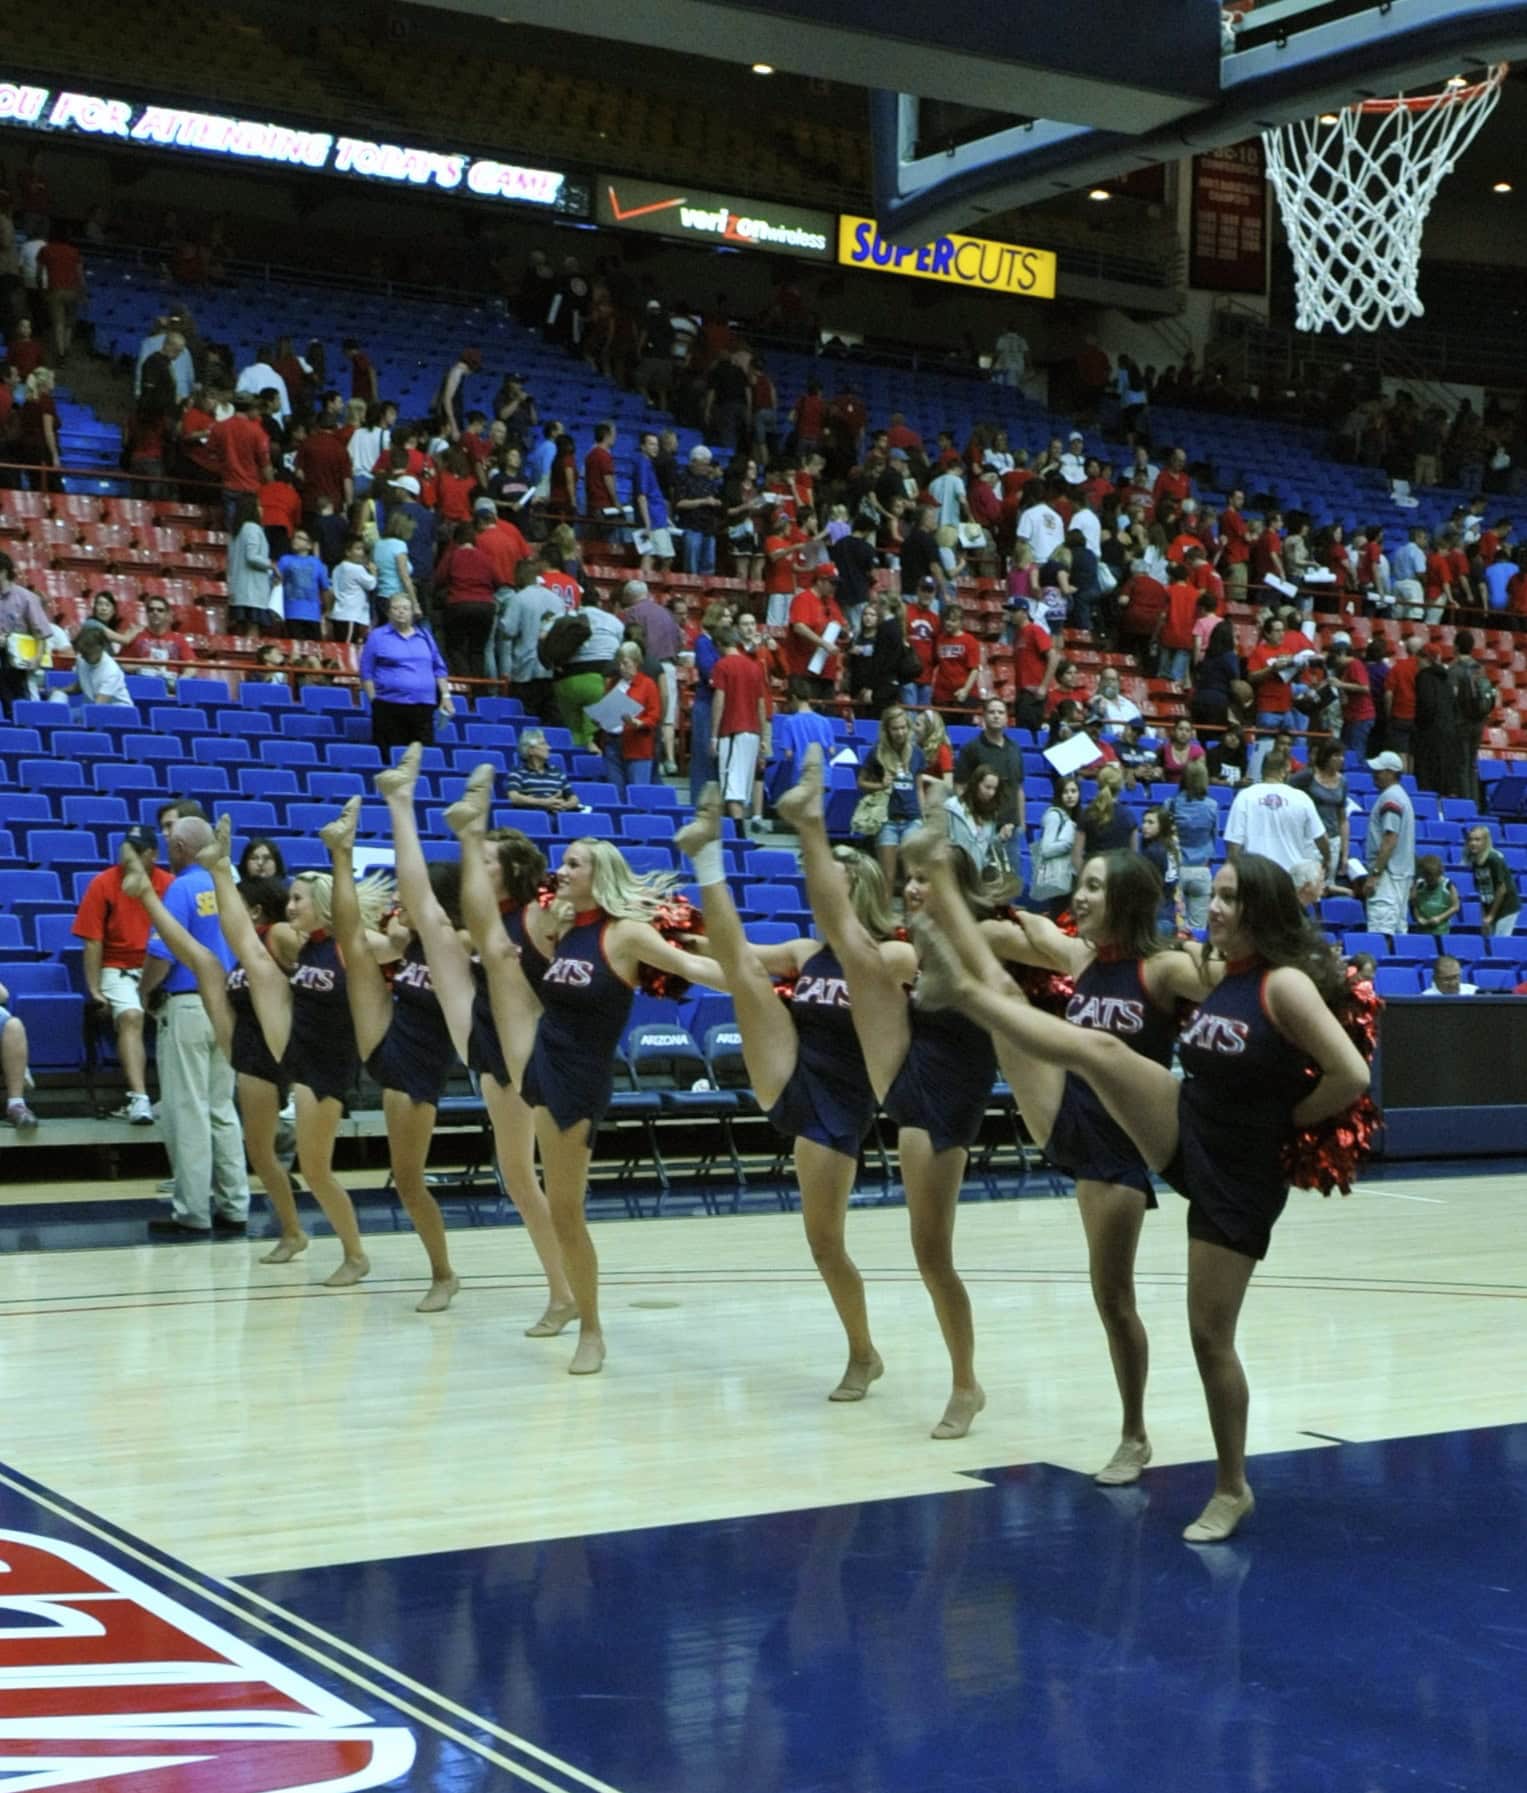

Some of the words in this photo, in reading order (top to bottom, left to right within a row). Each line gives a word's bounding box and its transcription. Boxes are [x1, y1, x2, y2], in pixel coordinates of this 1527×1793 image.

[49, 91, 132, 136] FOR
[131, 106, 333, 167] ATTENDING
[467, 160, 565, 205] GAME
[851, 222, 1039, 290] SUPERCUTS
[195, 890, 219, 917] SE
[1065, 993, 1145, 1034] CATS
[640, 1033, 689, 1046] ARIZONA
[715, 1032, 743, 1045] ARIZ
